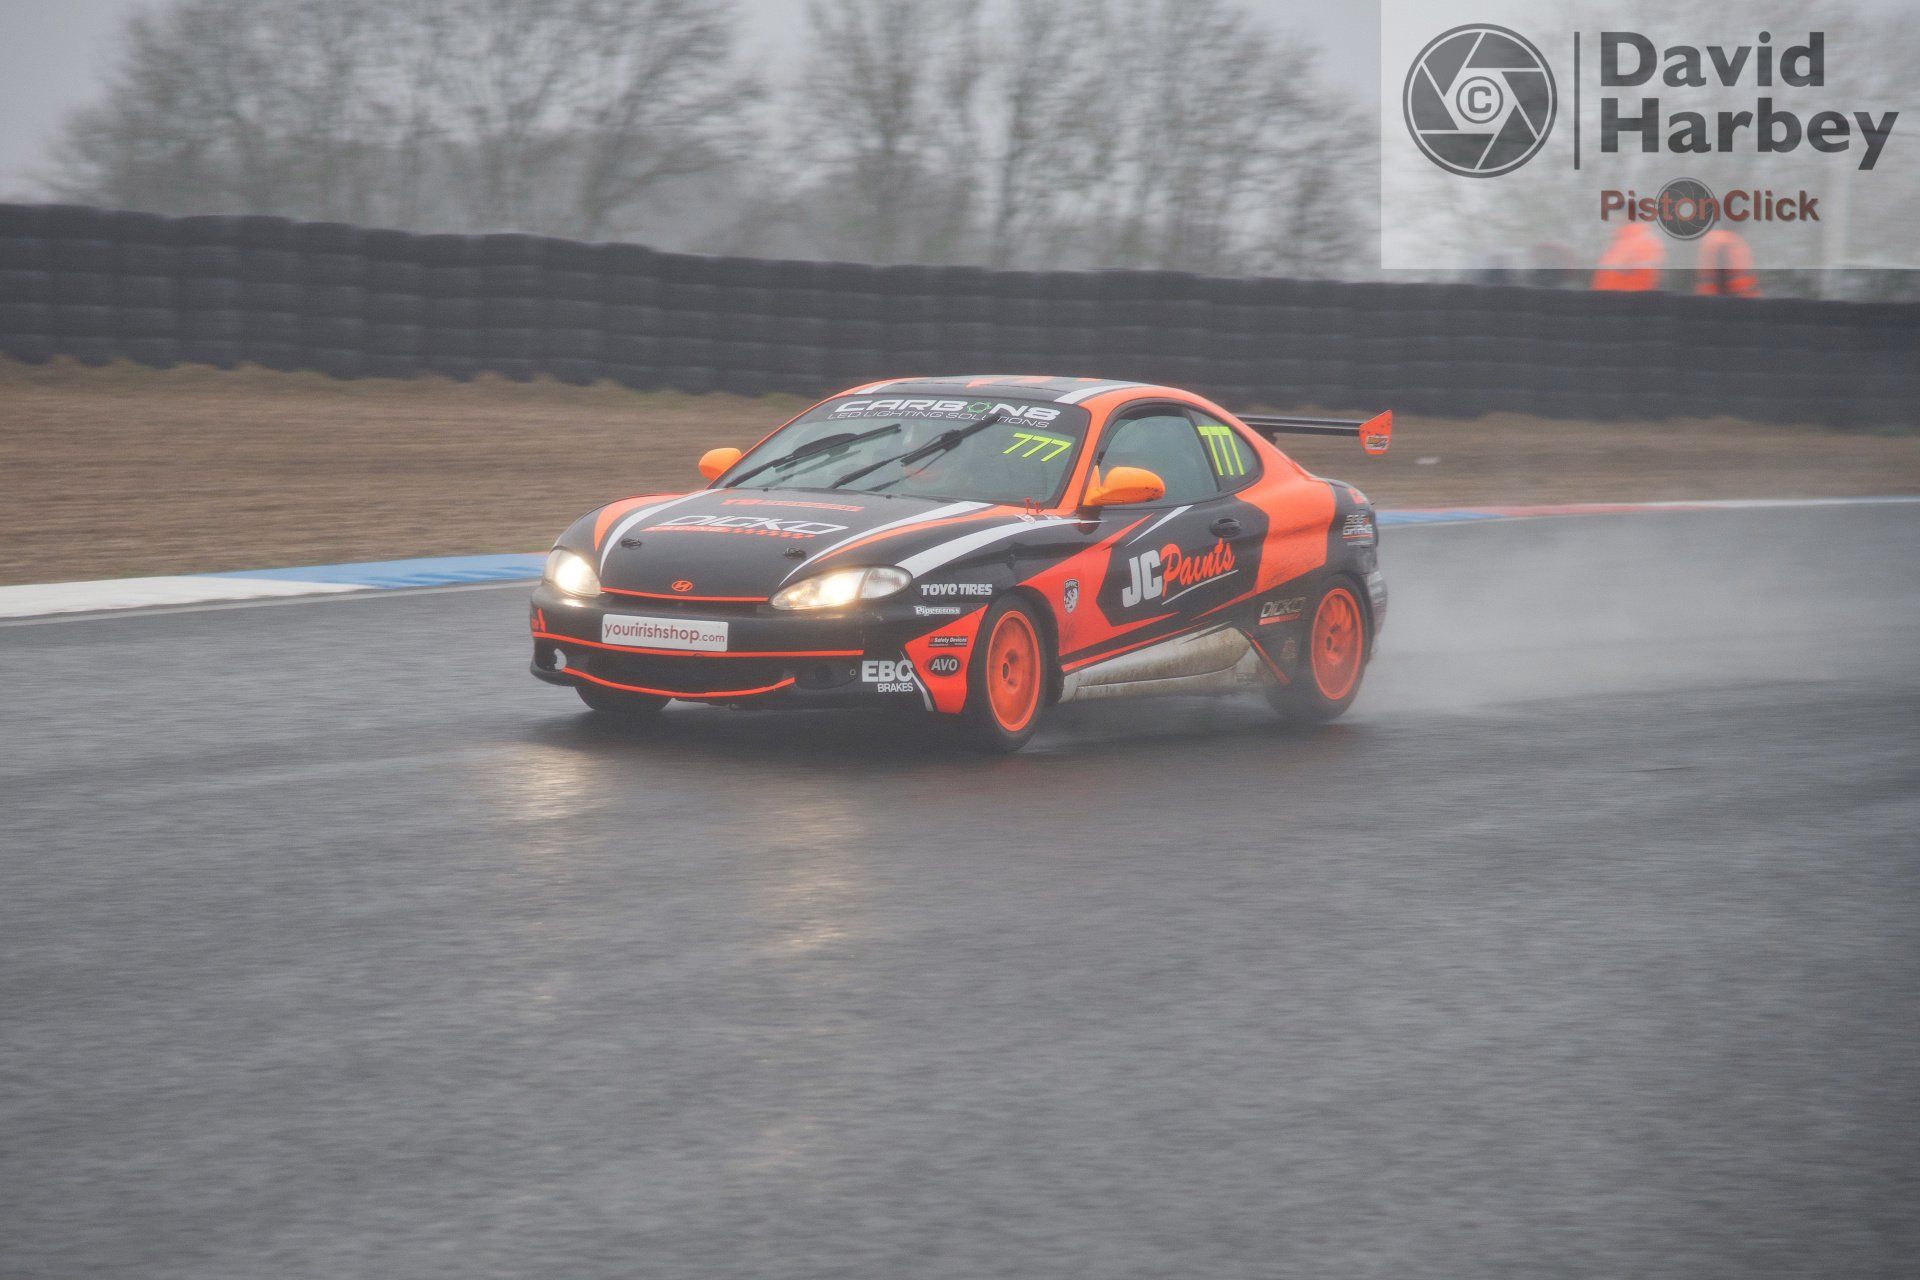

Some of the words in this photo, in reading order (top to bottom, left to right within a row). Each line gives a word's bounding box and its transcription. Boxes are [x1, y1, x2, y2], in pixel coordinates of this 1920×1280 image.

[827, 411, 861, 420] LED
[861, 410, 944, 419] LIGHTING
[1003, 432, 1073, 462] 777
[1197, 426, 1245, 476] 777
[656, 515, 849, 535] DICKO
[1122, 549, 1163, 608] JC
[1160, 537, 1236, 598] Paints
[920, 583, 958, 596] TOYO
[958, 583, 993, 596] TIRES
[604, 622, 726, 644] youririshshop.com
[862, 660, 914, 682] EBC
[931, 659, 958, 671] AVO
[877, 682, 914, 693] BRAKES
